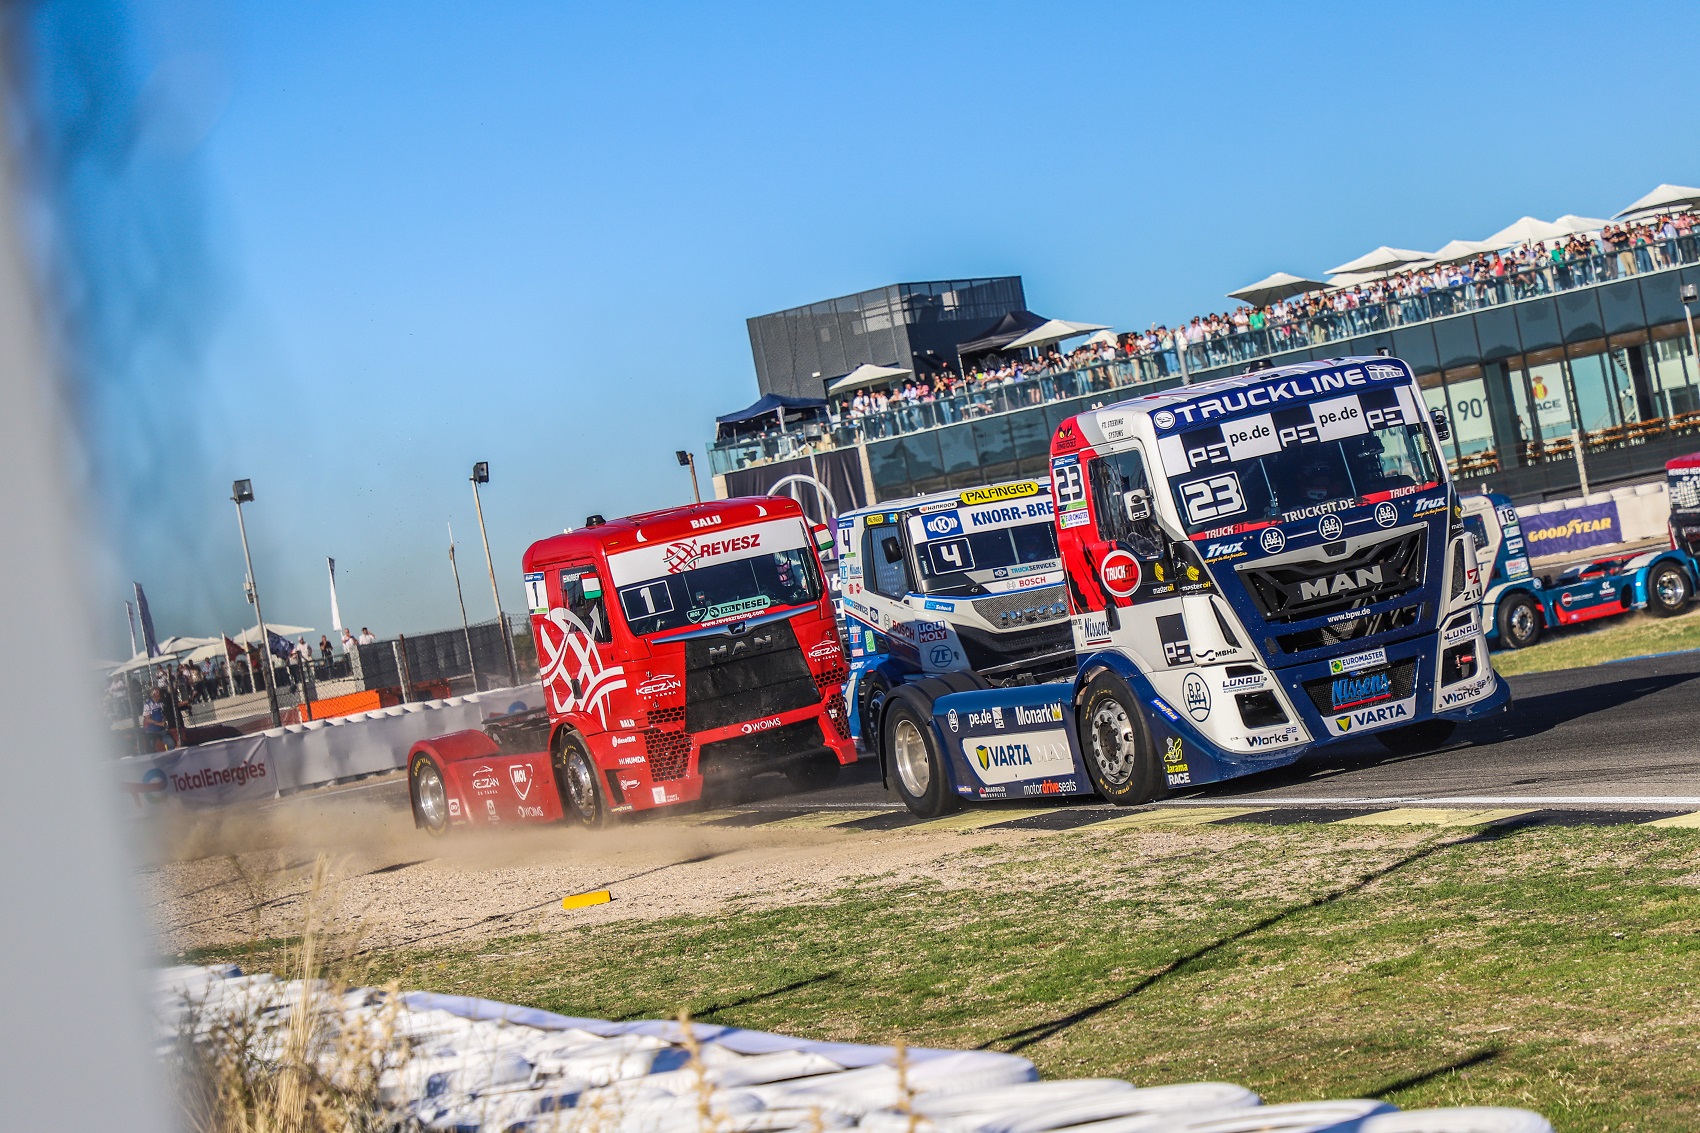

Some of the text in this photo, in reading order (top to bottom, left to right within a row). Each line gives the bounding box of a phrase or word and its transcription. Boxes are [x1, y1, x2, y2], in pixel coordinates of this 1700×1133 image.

[1174, 368, 1367, 422] TRUCKLINE
[1319, 407, 1358, 427] pe.de
[1366, 406, 1403, 429] PE
[1229, 425, 1271, 446] pe.de
[1279, 423, 1318, 447] PE
[1188, 442, 1228, 468] PE
[966, 482, 1034, 502] PALFINGER
[1055, 466, 1084, 503] 23
[1184, 476, 1243, 521] 23
[1415, 496, 1446, 513] Trux
[1282, 497, 1356, 523] TRUCKFIT.DE
[1502, 509, 1516, 523] 18
[690, 515, 722, 529] BALU
[1204, 523, 1246, 539] TRUCKFIT
[1528, 517, 1612, 542] GOODYEAR
[700, 534, 760, 558] REVESZ
[842, 529, 851, 552] 4
[1206, 541, 1244, 558] Trux
[939, 544, 963, 567] 4
[1011, 562, 1057, 574] TRUCKSERVICES
[1106, 564, 1133, 581] TRUCKFIT
[1019, 576, 1047, 588] BOSCH
[1300, 565, 1383, 601] MAN
[532, 582, 539, 607] 1
[639, 587, 656, 614] 1
[721, 598, 768, 614] XXL DIESEL
[1000, 602, 1067, 626] IVECO
[1327, 608, 1371, 623] www.bpw.de
[701, 609, 765, 628] www.reveszracing.com
[918, 621, 945, 633] LIQUI
[1084, 617, 1109, 638] Nissens
[892, 620, 915, 640] BOSCH
[920, 631, 946, 643] MOLY
[1447, 624, 1478, 640] LUNAU
[708, 635, 773, 660] MAN
[931, 649, 950, 663] ZF
[1164, 641, 1192, 665] PE
[1215, 648, 1238, 658] MBHA
[1342, 651, 1384, 666] EUROMASTER
[1222, 675, 1260, 688] LUNAU
[1332, 673, 1389, 703] Nissens
[1442, 687, 1481, 705] Works
[619, 719, 635, 728] BALU
[752, 717, 782, 731] WOIMS
[969, 709, 993, 728] pe.de
[1015, 704, 1053, 726] Monark
[1353, 704, 1408, 726] VARTA
[1246, 734, 1289, 747] Works
[1286, 726, 1297, 734] 22
[625, 756, 646, 765] HUMDA
[988, 744, 1033, 767] VARTA
[170, 760, 266, 792] TotalEnergies
[514, 770, 527, 783] MOL
[1167, 764, 1188, 774] Jarama
[1023, 779, 1077, 796] motordriveseats
[1168, 773, 1191, 785] RACE
[524, 806, 544, 817] WOIMS
